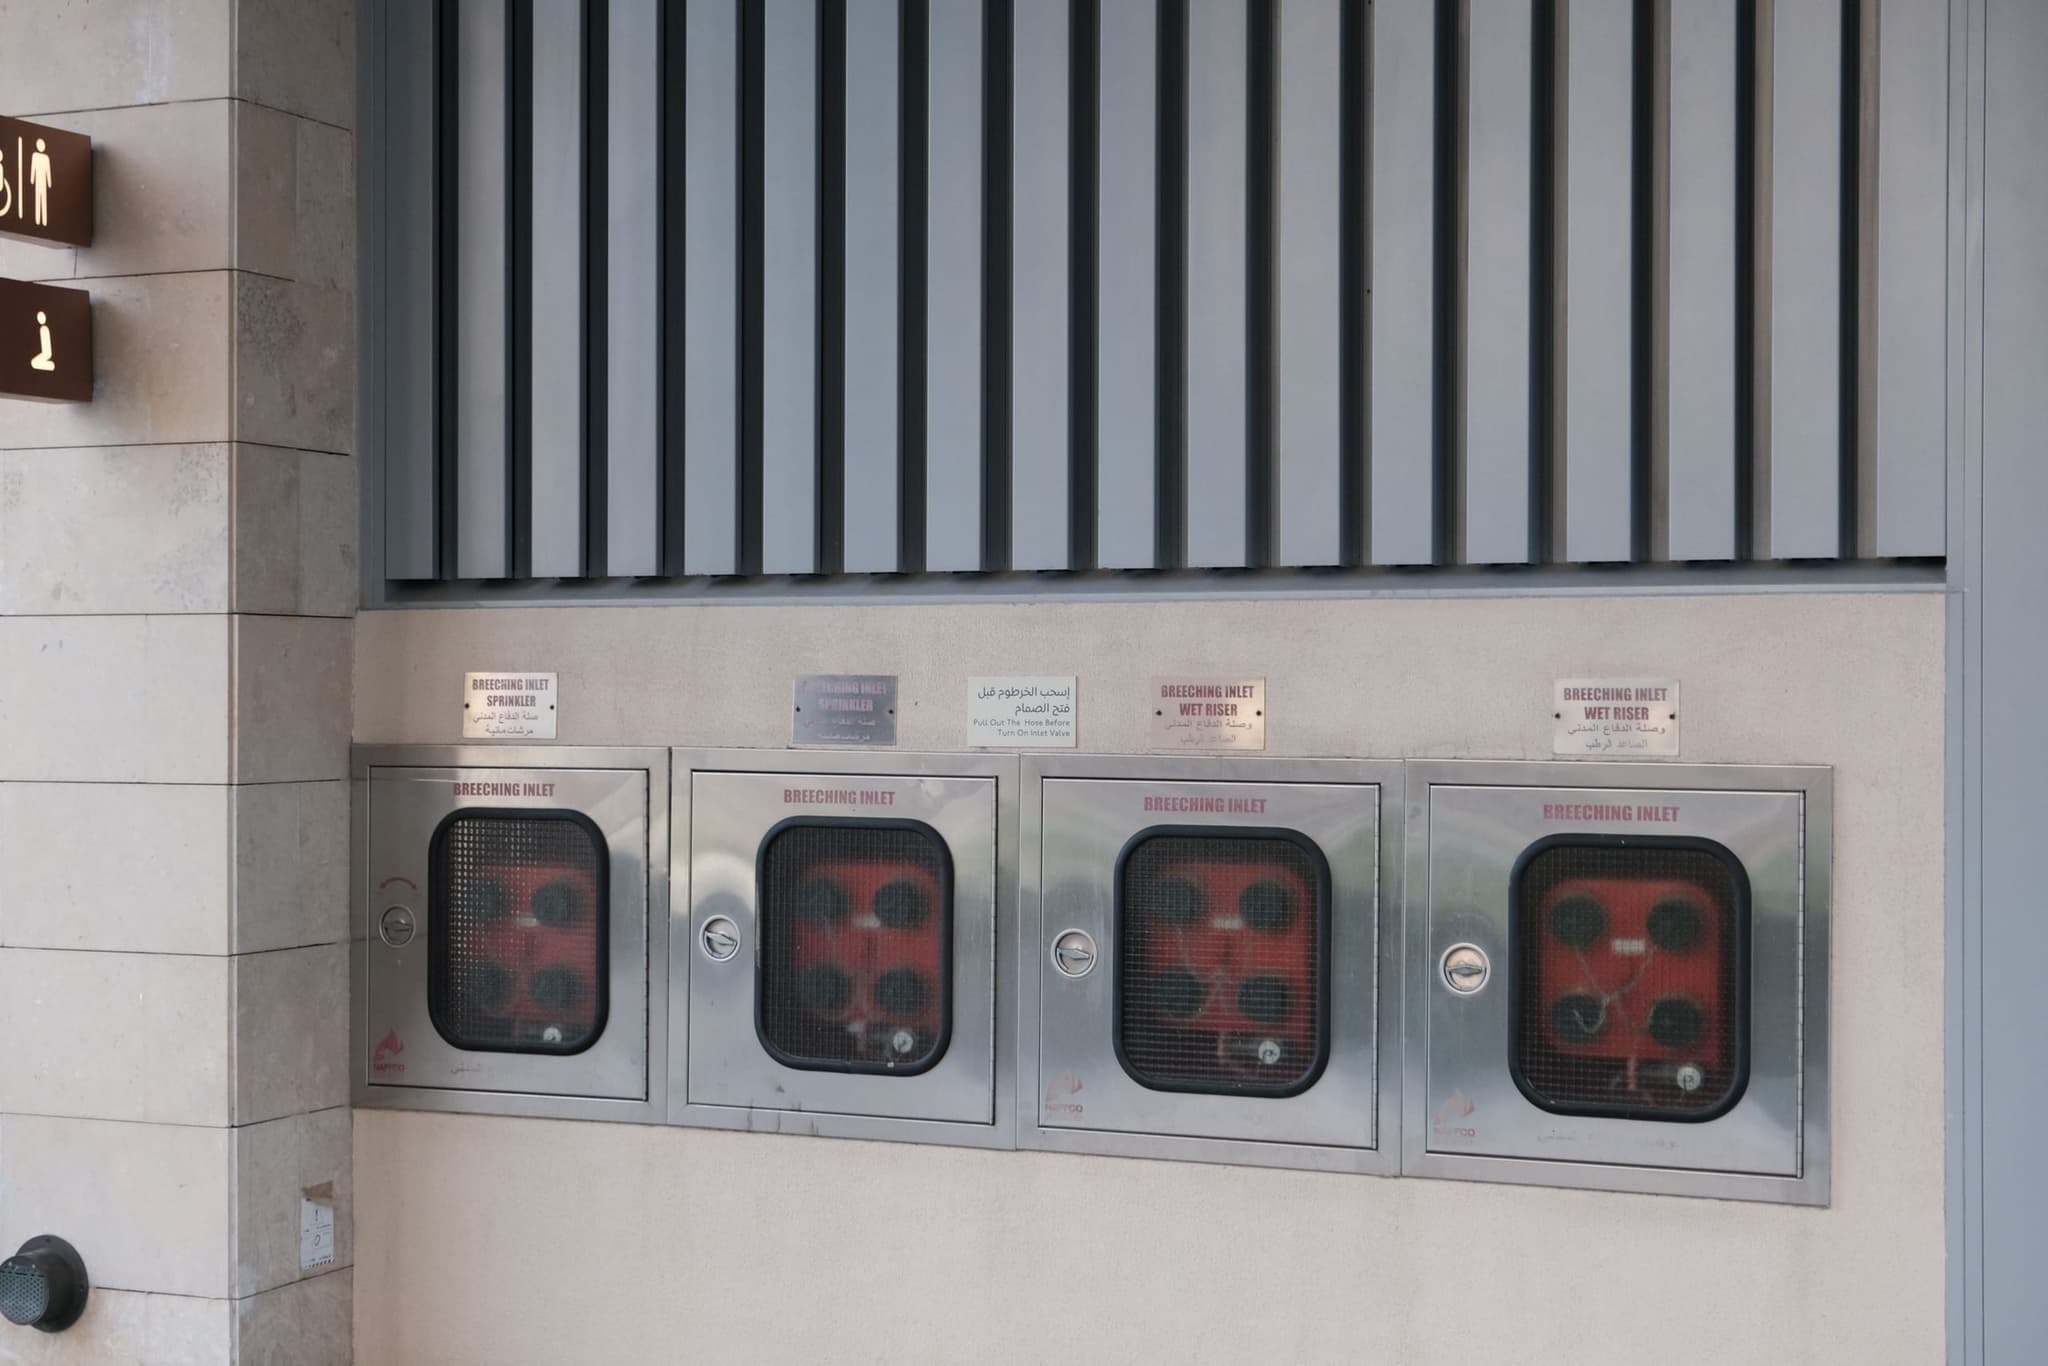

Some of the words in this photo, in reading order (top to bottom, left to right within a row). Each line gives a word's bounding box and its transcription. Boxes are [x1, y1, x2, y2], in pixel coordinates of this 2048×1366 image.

[472, 679, 523, 690] BREECHING
[525, 679, 549, 690] INLET
[1161, 684, 1222, 698] BREECHING
[1225, 685, 1255, 698] INLET
[978, 686, 996, 700] قبل
[998, 686, 1038, 700] الخرطوم
[1040, 686, 1070, 700] إسحب
[1563, 687, 1632, 701] BREECHING
[1635, 688, 1668, 702] INLET
[487, 695, 536, 707] SPRINKLER
[1014, 703, 1050, 717] الصمام
[1052, 704, 1070, 716] فتح
[1179, 703, 1203, 716] WET
[1205, 703, 1238, 716] RISER
[1584, 707, 1610, 720] WET
[1613, 707, 1649, 720] RISER
[973, 718, 988, 727] Pull
[989, 718, 1005, 727] Out
[1006, 718, 1020, 727] The
[1025, 718, 1044, 727] Hose
[1045, 718, 1071, 727] Before
[1602, 723, 1632, 736] الدفاع
[1636, 723, 1666, 735] وصلة
[998, 729, 1015, 737] Turn
[1017, 729, 1029, 737] On
[1030, 729, 1048, 737] Inlet
[1050, 729, 1071, 737] Valve
[453, 783, 520, 796] BREECHING
[523, 783, 555, 797] INLET
[783, 789, 857, 804] BREECHING
[860, 790, 896, 805] INLET
[1143, 797, 1225, 812] BREECHING
[1228, 798, 1267, 813] INLET
[1543, 804, 1632, 820] BREECHING
[1636, 806, 1680, 822] INLET
